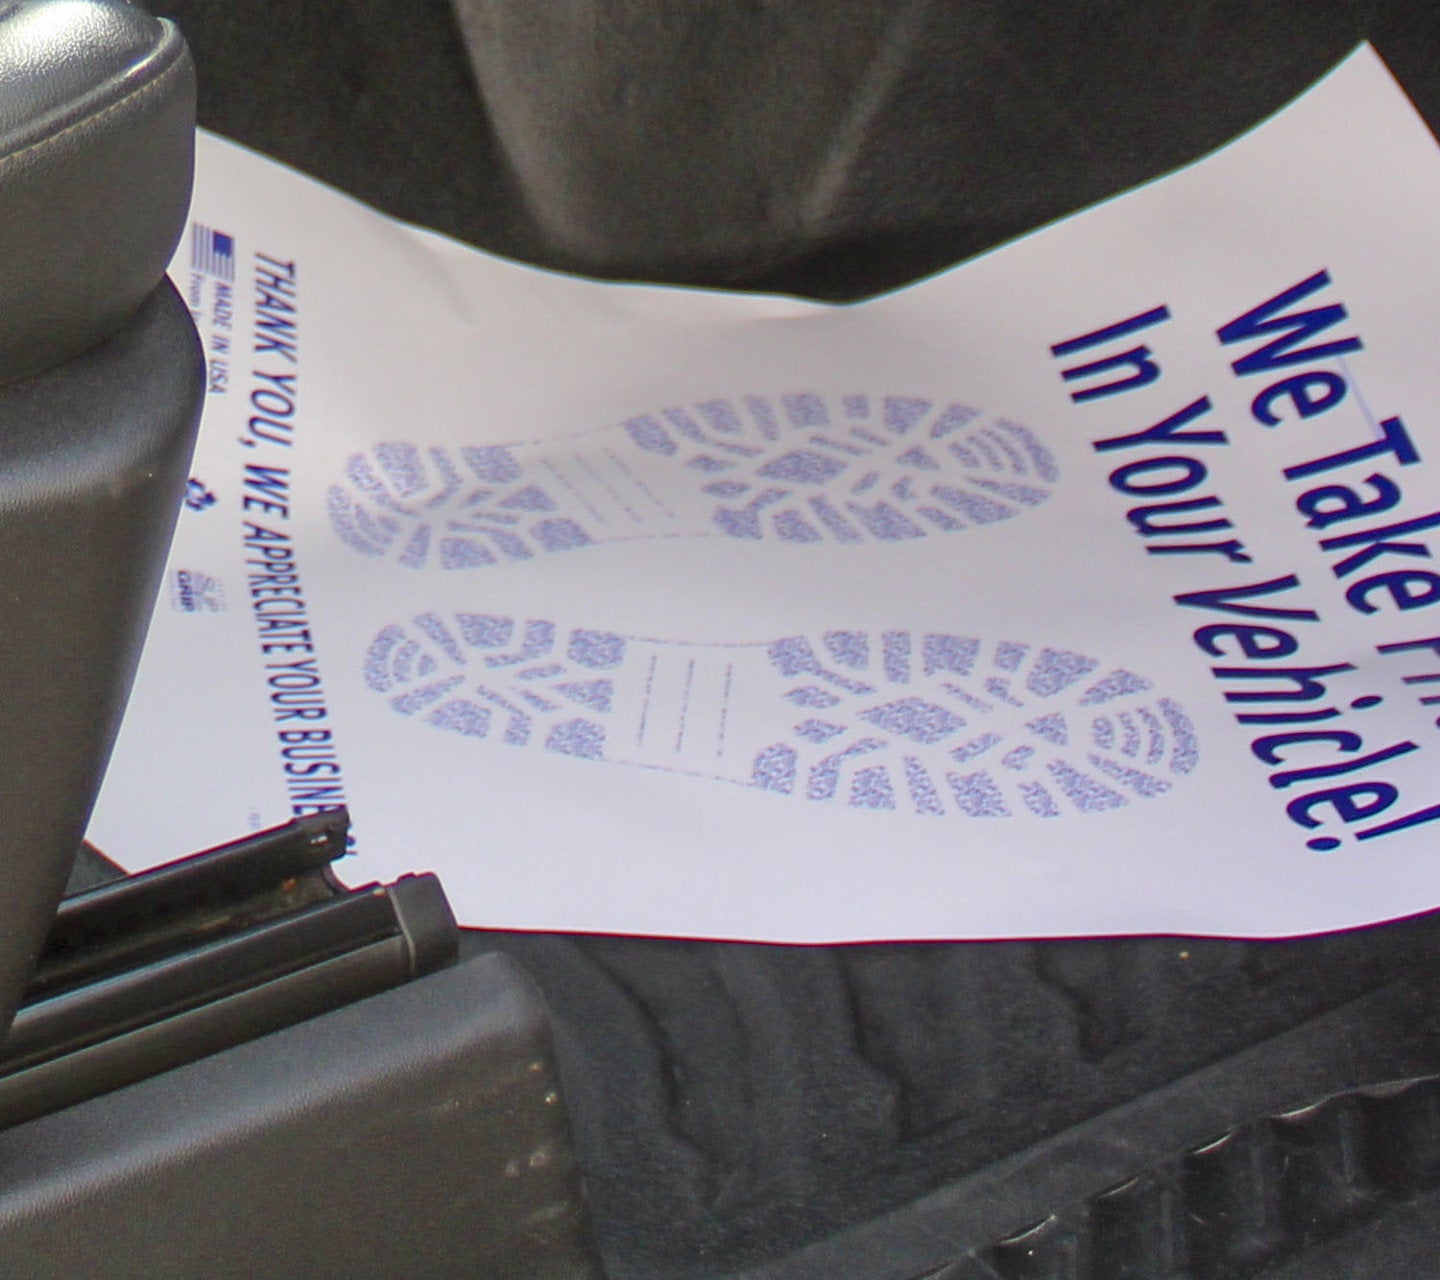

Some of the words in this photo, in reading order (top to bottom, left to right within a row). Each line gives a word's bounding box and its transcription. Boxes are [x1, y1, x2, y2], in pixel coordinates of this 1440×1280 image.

[211, 281, 233, 329] MADE
[211, 334, 230, 352] IN
[253, 251, 298, 364] THANK
[1216, 268, 1364, 428] We
[208, 358, 229, 394] USA
[1050, 304, 1172, 403] In
[238, 370, 297, 448] YOU,
[242, 463, 291, 520] WE
[1092, 395, 1253, 564] Your
[241, 520, 314, 654] APPRECIATE
[264, 658, 327, 722] YOUR
[277, 729, 357, 855] BUSINE
